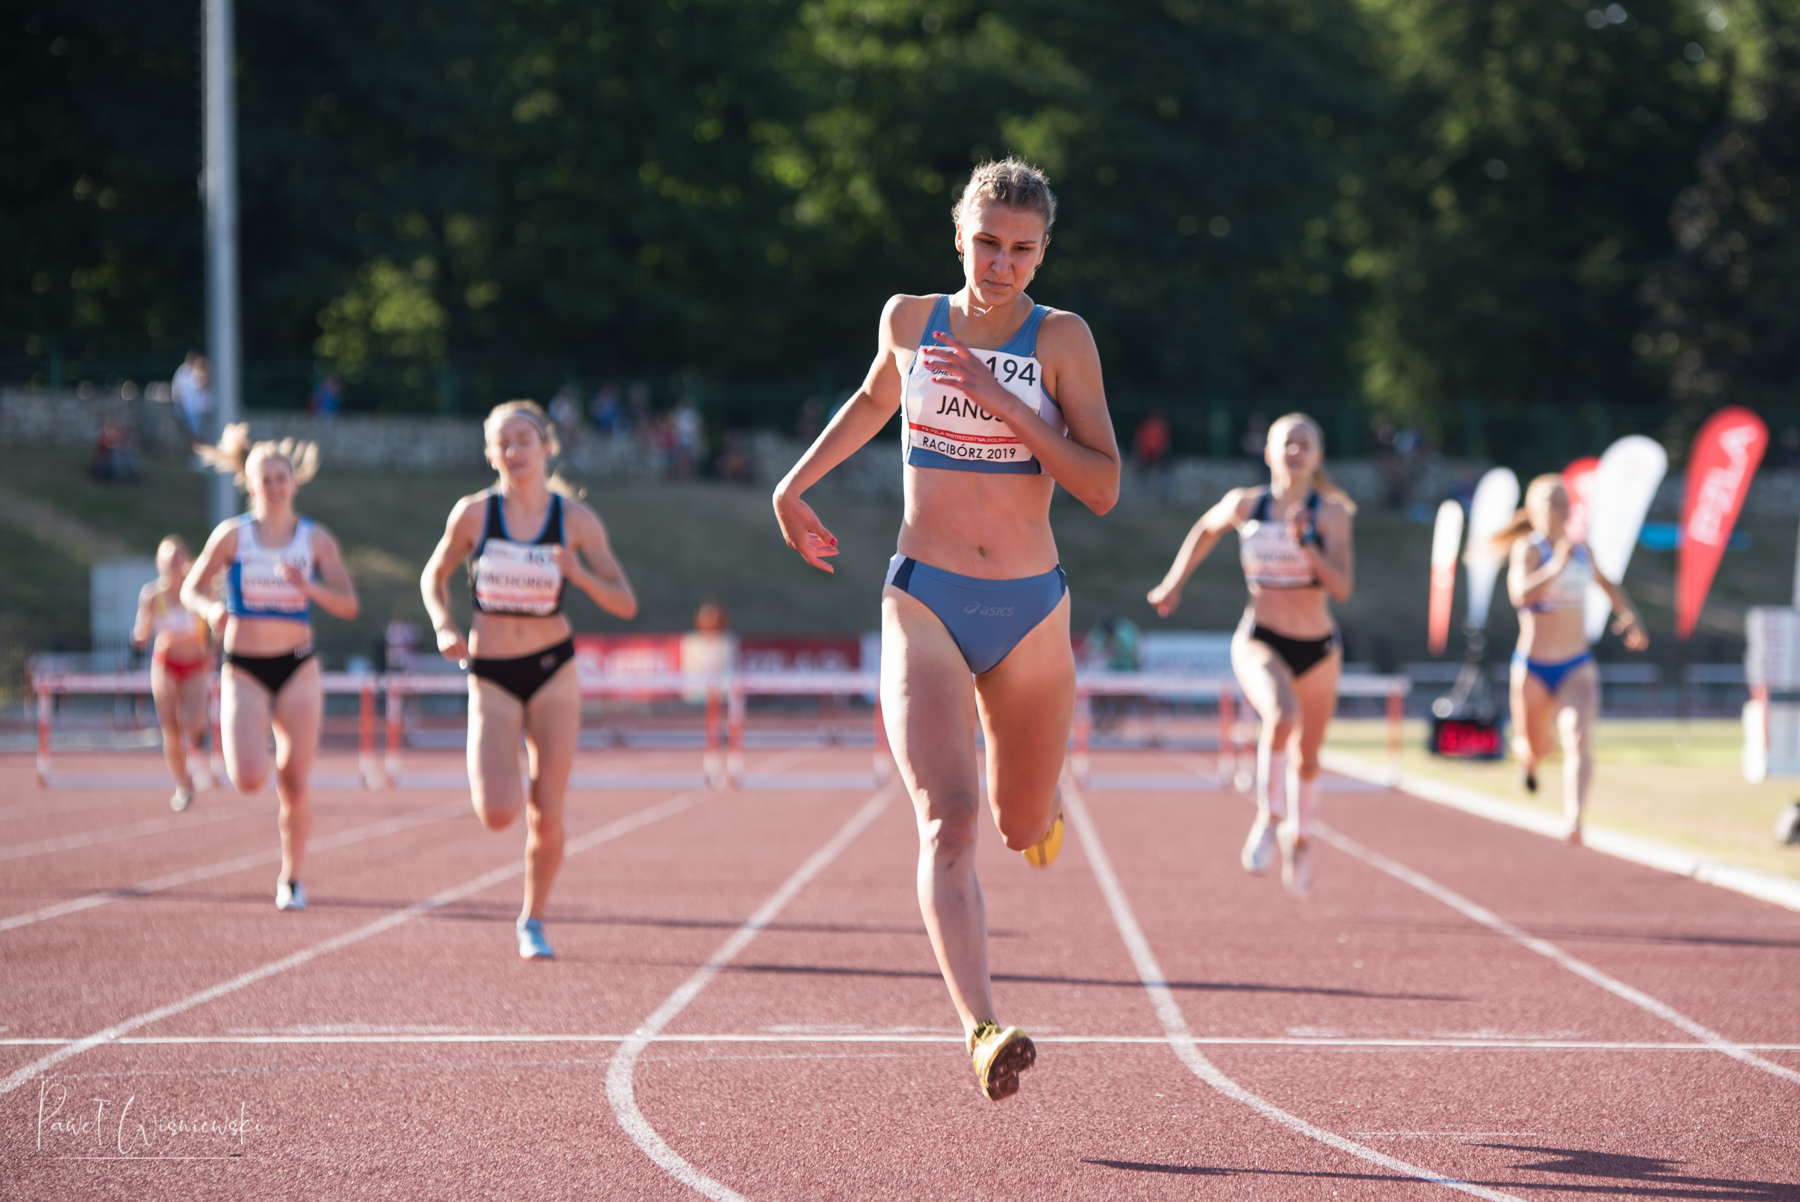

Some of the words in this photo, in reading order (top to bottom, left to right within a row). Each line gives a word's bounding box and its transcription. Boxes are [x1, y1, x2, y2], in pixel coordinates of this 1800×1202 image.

[986, 356, 1036, 386] 194
[936, 395, 1004, 422] JANU
[922, 436, 982, 458] RACIBÓRZ
[986, 448, 1016, 459] 2019
